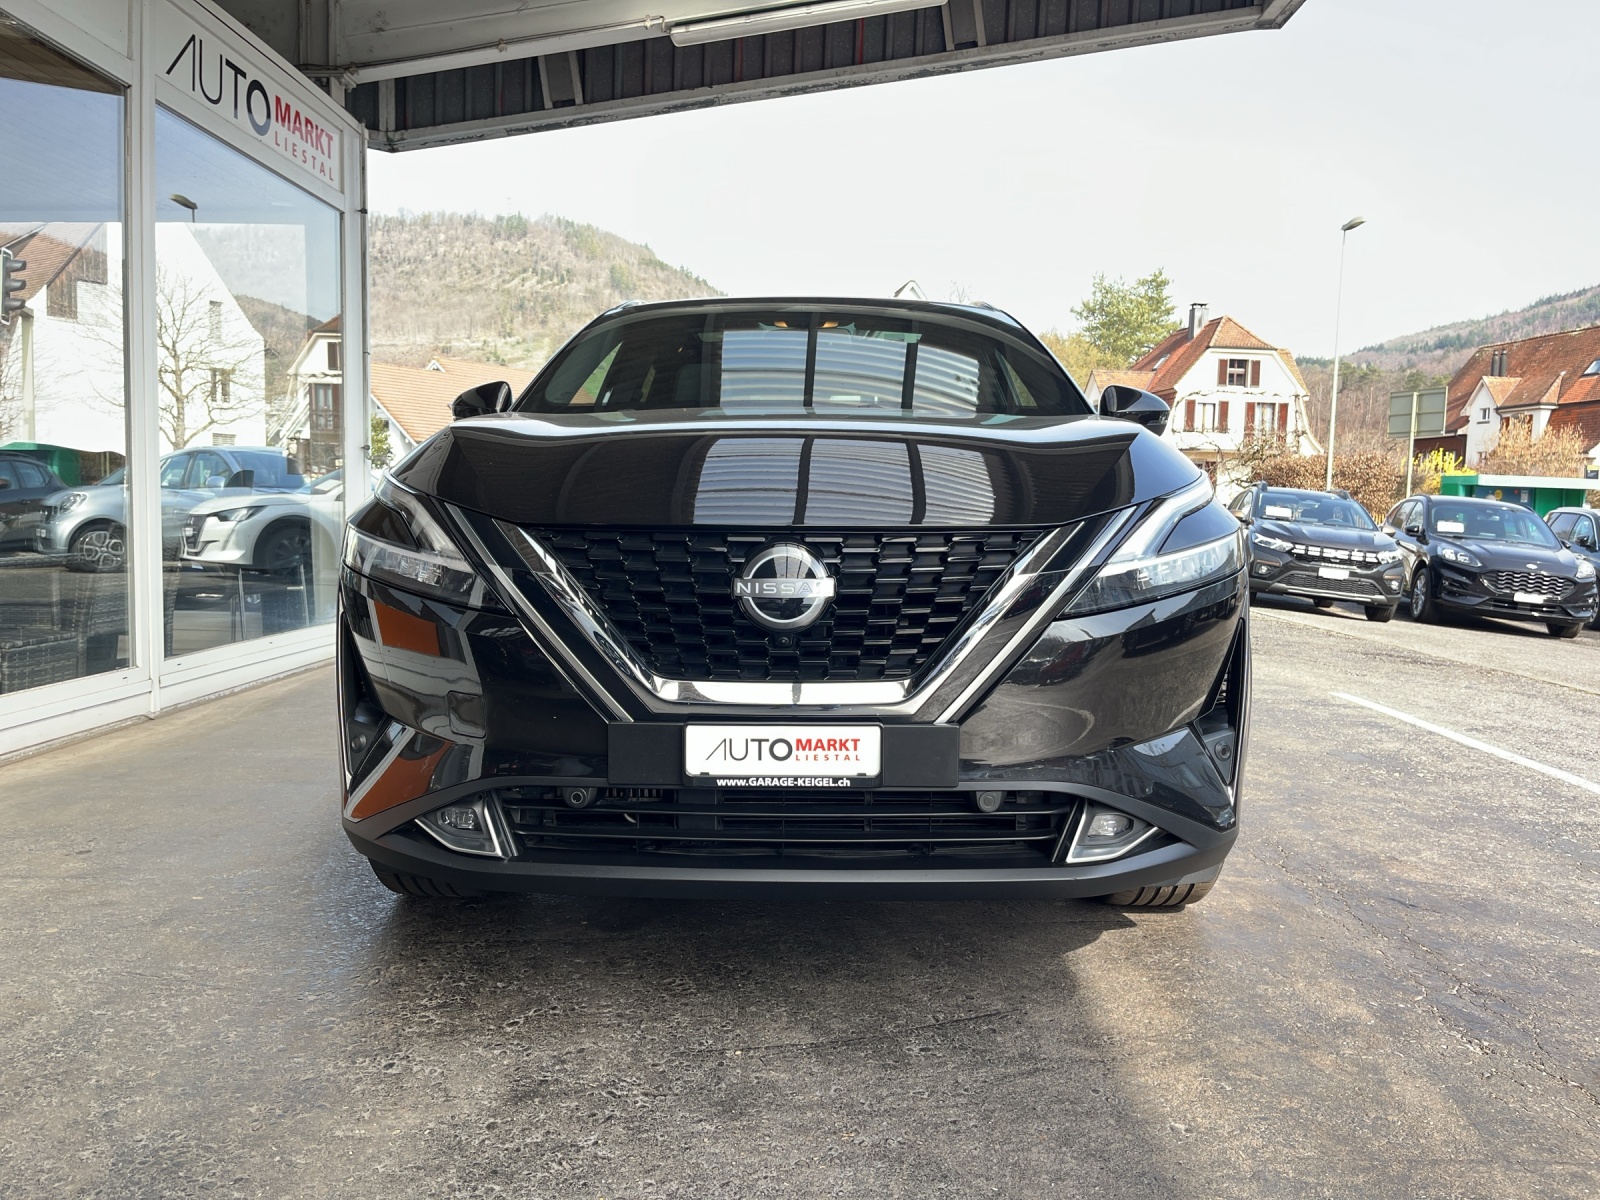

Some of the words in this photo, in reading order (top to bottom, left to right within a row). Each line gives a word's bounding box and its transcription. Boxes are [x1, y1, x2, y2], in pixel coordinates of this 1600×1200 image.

[275, 131, 333, 182] LIESTAL
[736, 582, 833, 594] NISSA
[706, 738, 793, 761] AUTO
[795, 738, 861, 752] MARKT
[716, 777, 851, 787] www.GARAGE-KEIGEL.ch
